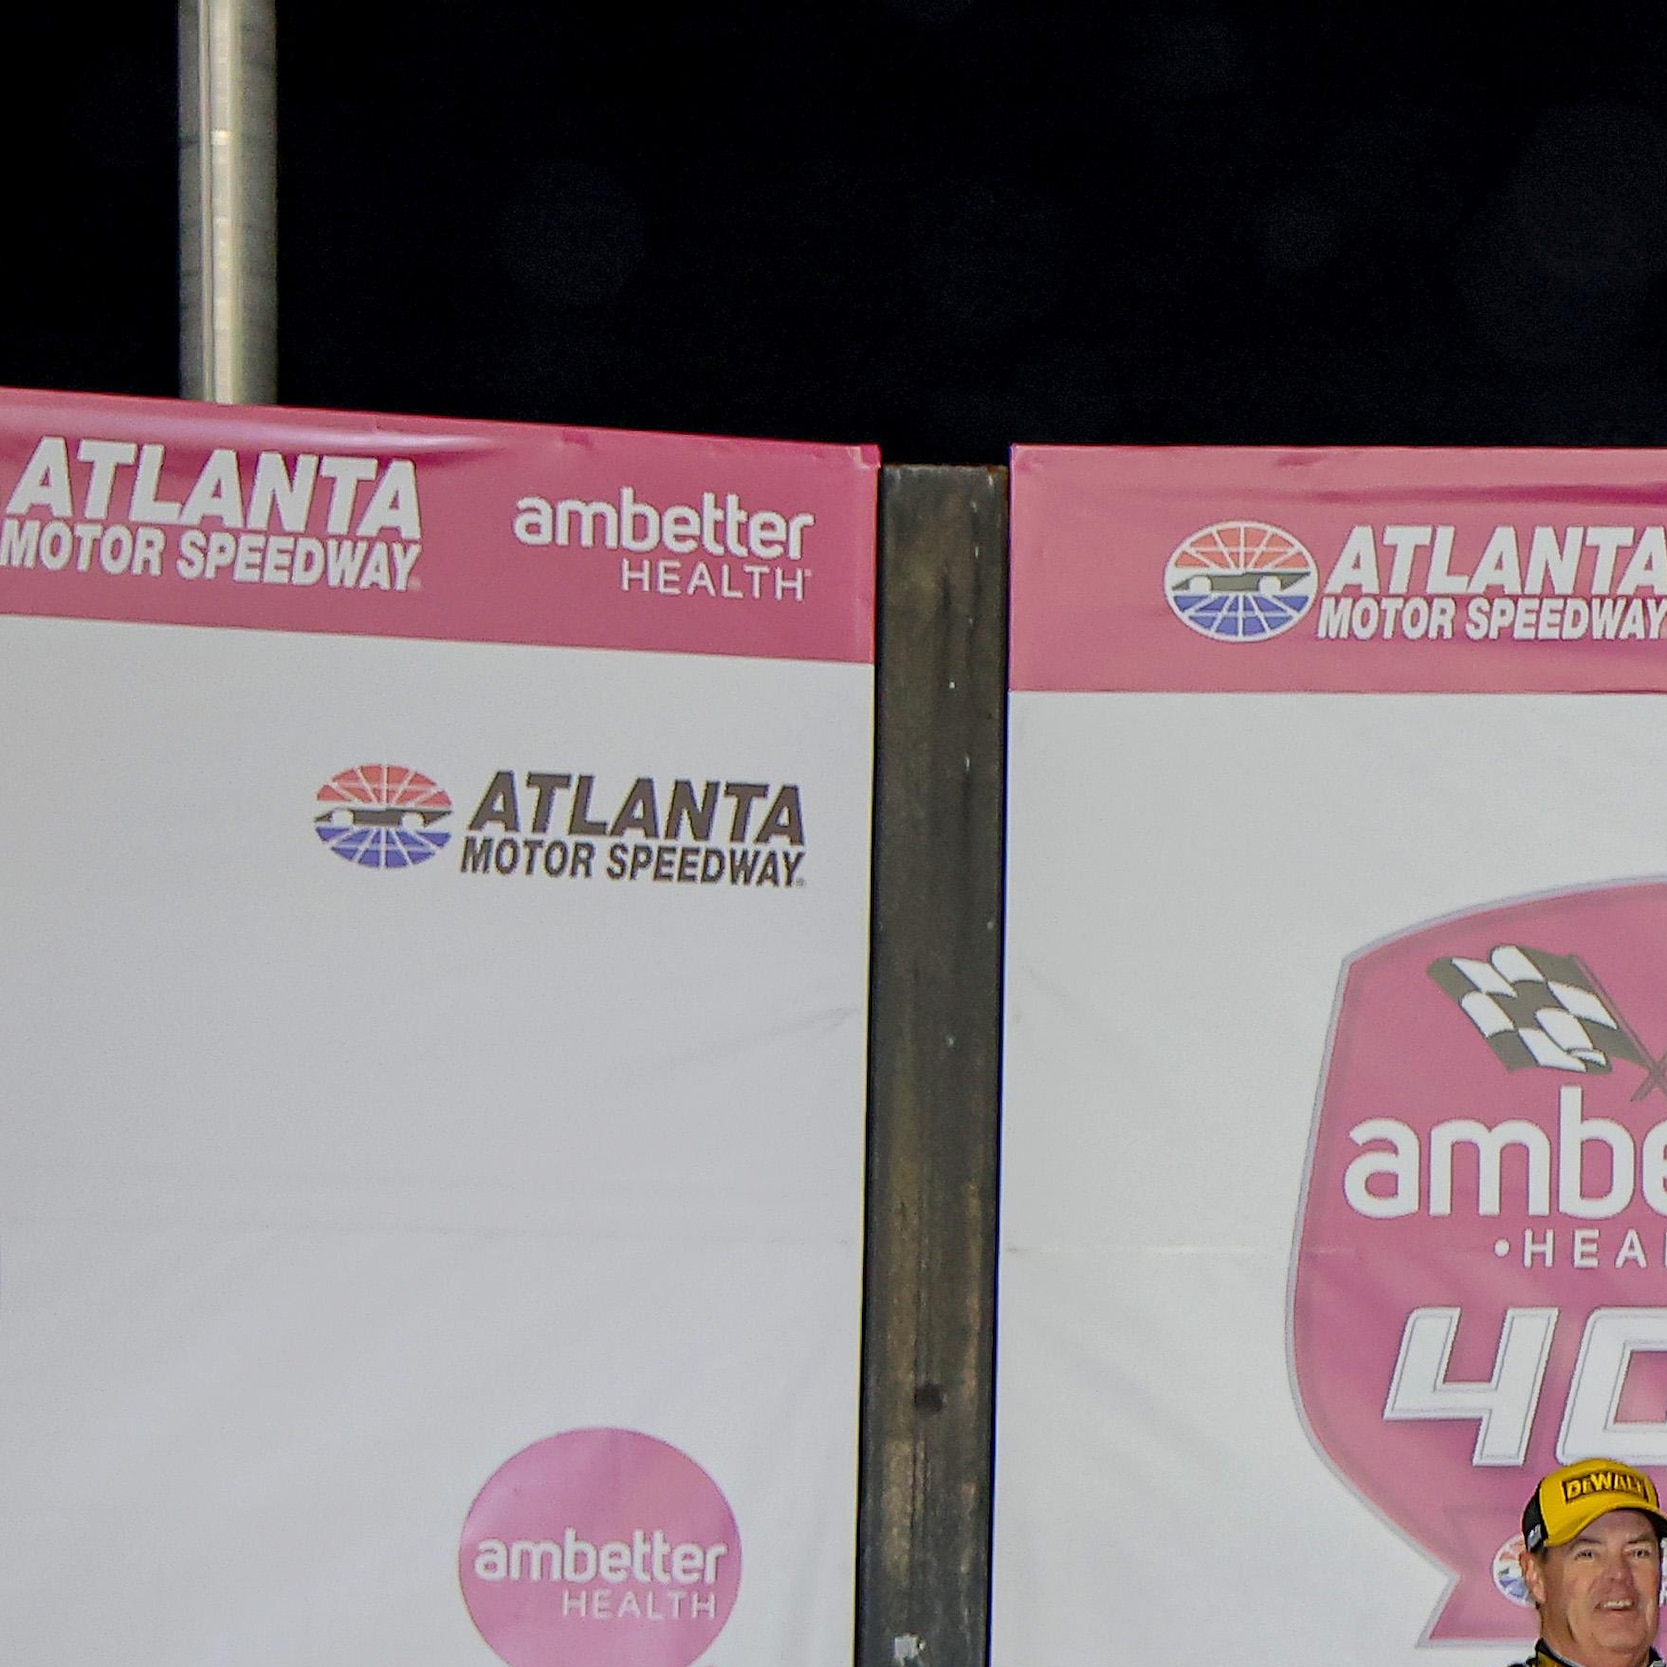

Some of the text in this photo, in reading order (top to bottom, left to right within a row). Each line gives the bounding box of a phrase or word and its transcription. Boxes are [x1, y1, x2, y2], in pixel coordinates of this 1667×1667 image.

[4, 436, 422, 538] ATLANTA
[513, 487, 815, 560] ambetter
[0, 518, 423, 592] MOTOR SPEEDWAY
[621, 559, 806, 602] HEALTH
[1317, 597, 1473, 640] MOTOR
[468, 769, 805, 847] ATLANTA
[460, 837, 805, 888] MOTOR SPEEDWAY
[474, 1527, 728, 1585] ambetter
[562, 1589, 717, 1620] HEALTH
